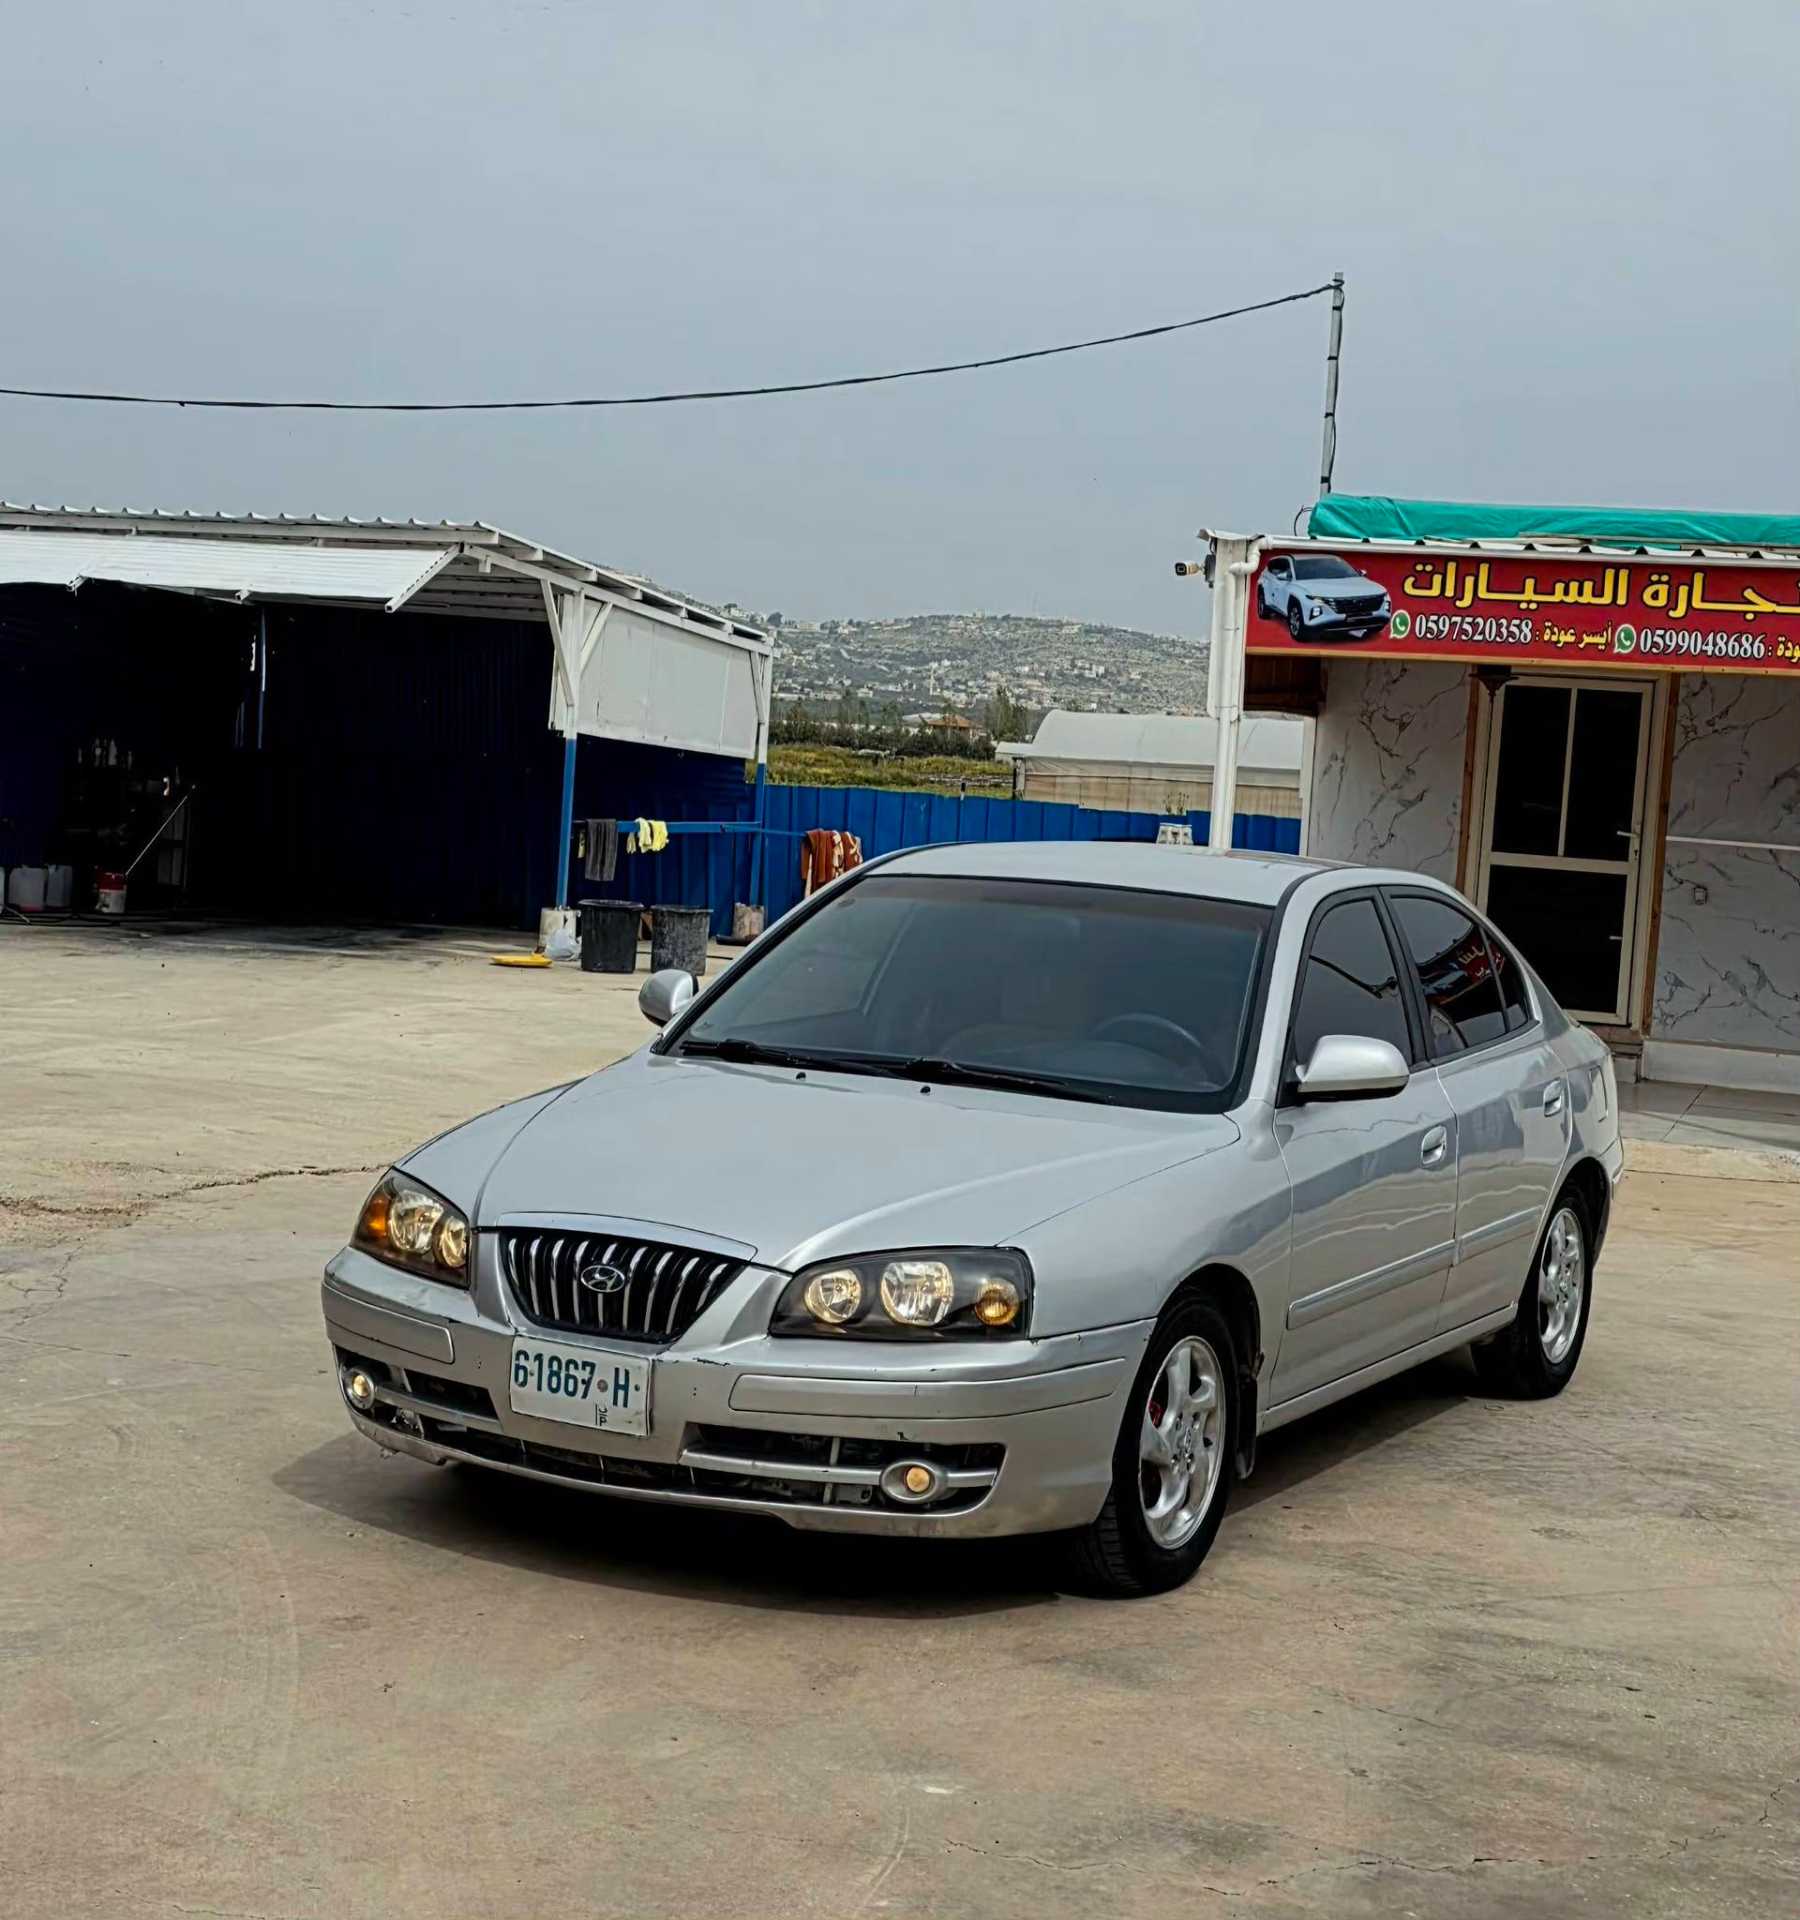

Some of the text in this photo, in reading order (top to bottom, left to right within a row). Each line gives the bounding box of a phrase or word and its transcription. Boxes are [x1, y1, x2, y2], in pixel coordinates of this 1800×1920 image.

[1403, 561, 1800, 620] جارة السيارات
[1414, 613, 1532, 644] 0597520358
[1543, 622, 1576, 648] عودة
[1640, 627, 1766, 659] 0599048686
[1776, 636, 1800, 663] ودة
[514, 1349, 630, 1408] 61867 H
